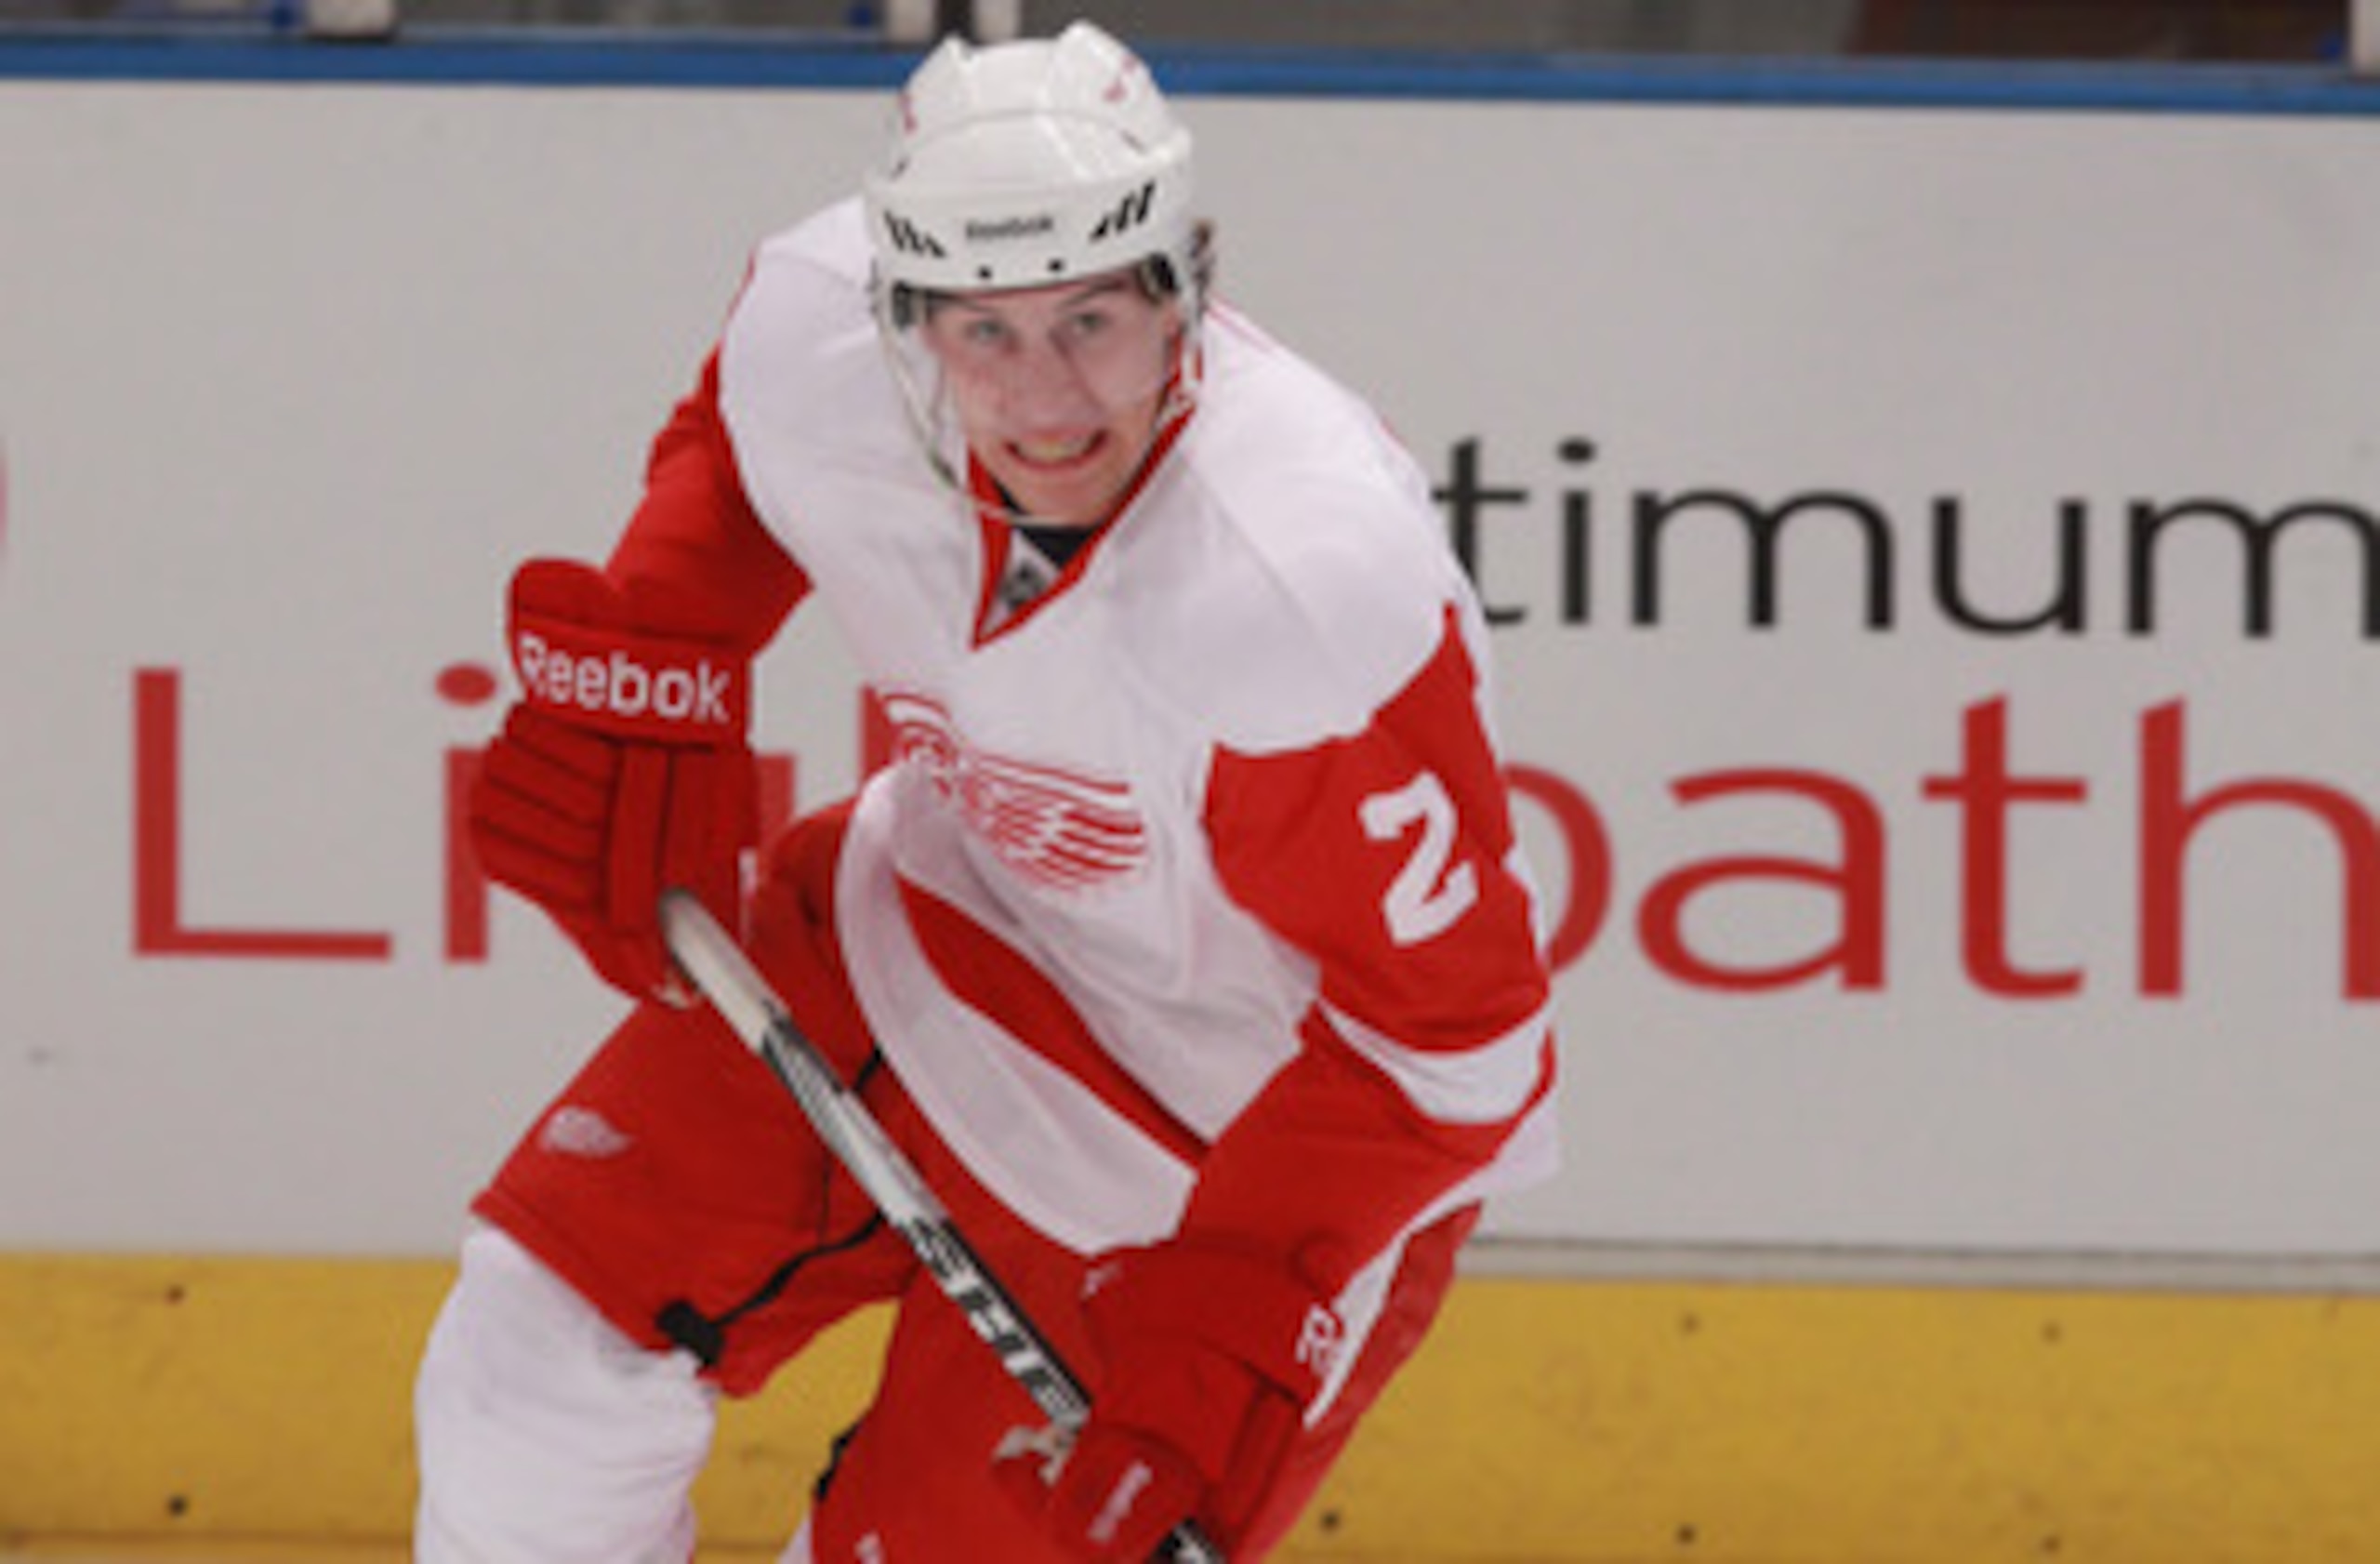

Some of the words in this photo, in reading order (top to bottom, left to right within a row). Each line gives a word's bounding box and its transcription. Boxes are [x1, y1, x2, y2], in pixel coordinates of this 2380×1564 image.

[1432, 435, 2380, 640] timum
[518, 630, 732, 723] Reebok
[1359, 769, 1479, 947] 2
